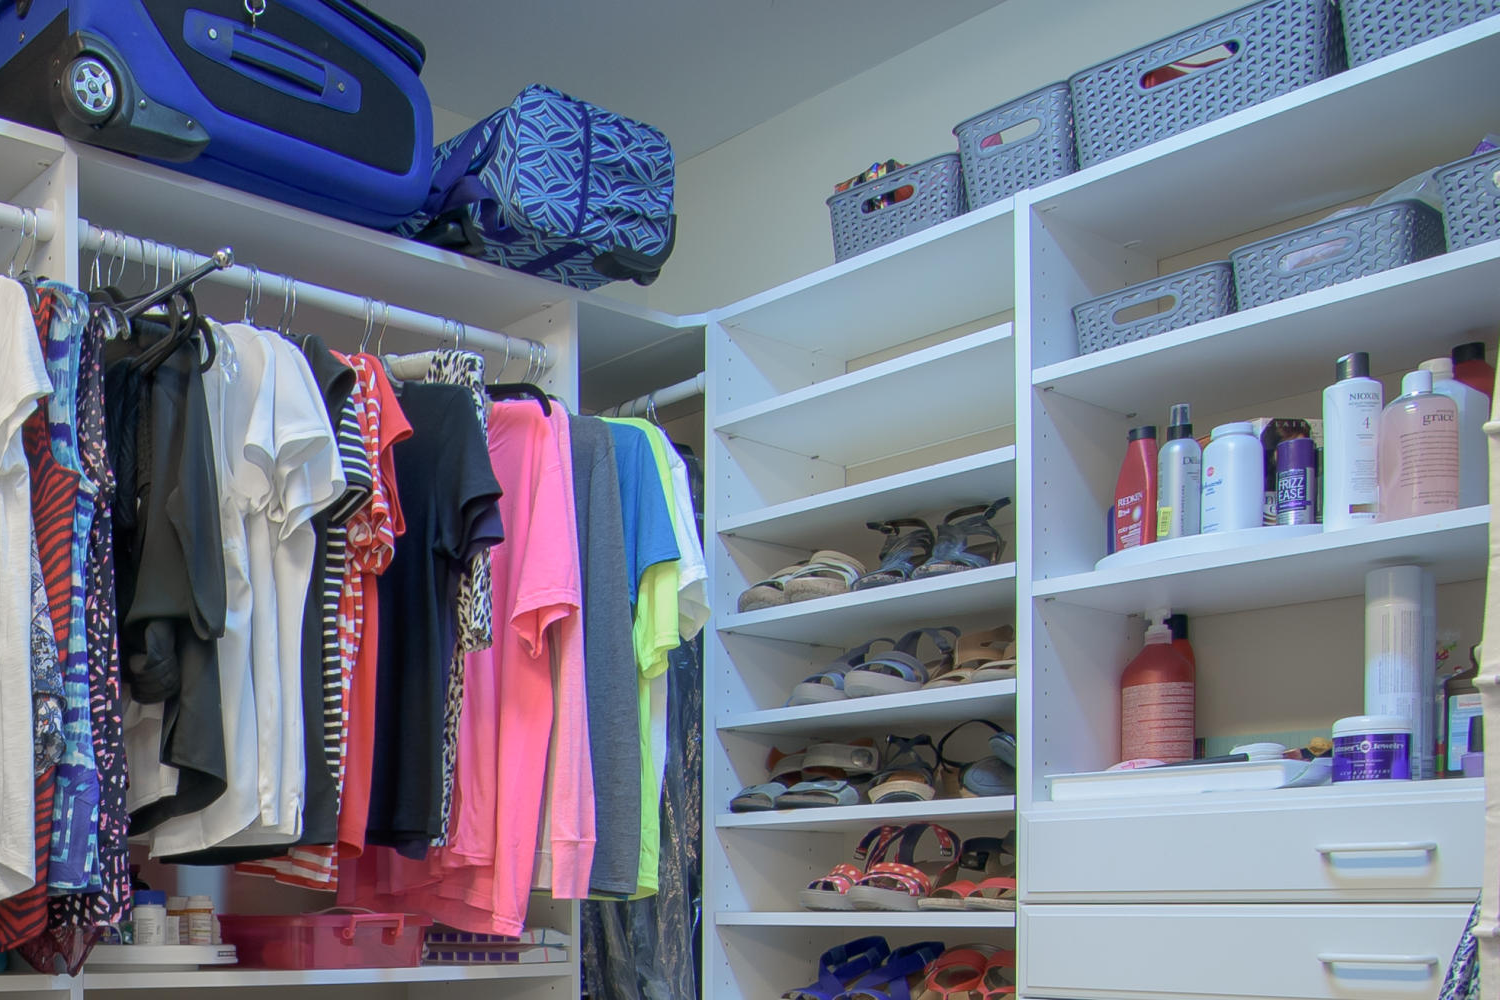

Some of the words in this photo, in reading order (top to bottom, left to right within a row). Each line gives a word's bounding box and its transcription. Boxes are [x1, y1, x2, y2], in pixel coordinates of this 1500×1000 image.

[1363, 416, 1371, 429] 4
[1279, 477, 1304, 490] FRIZZ
[1278, 488, 1304, 500] EASE
